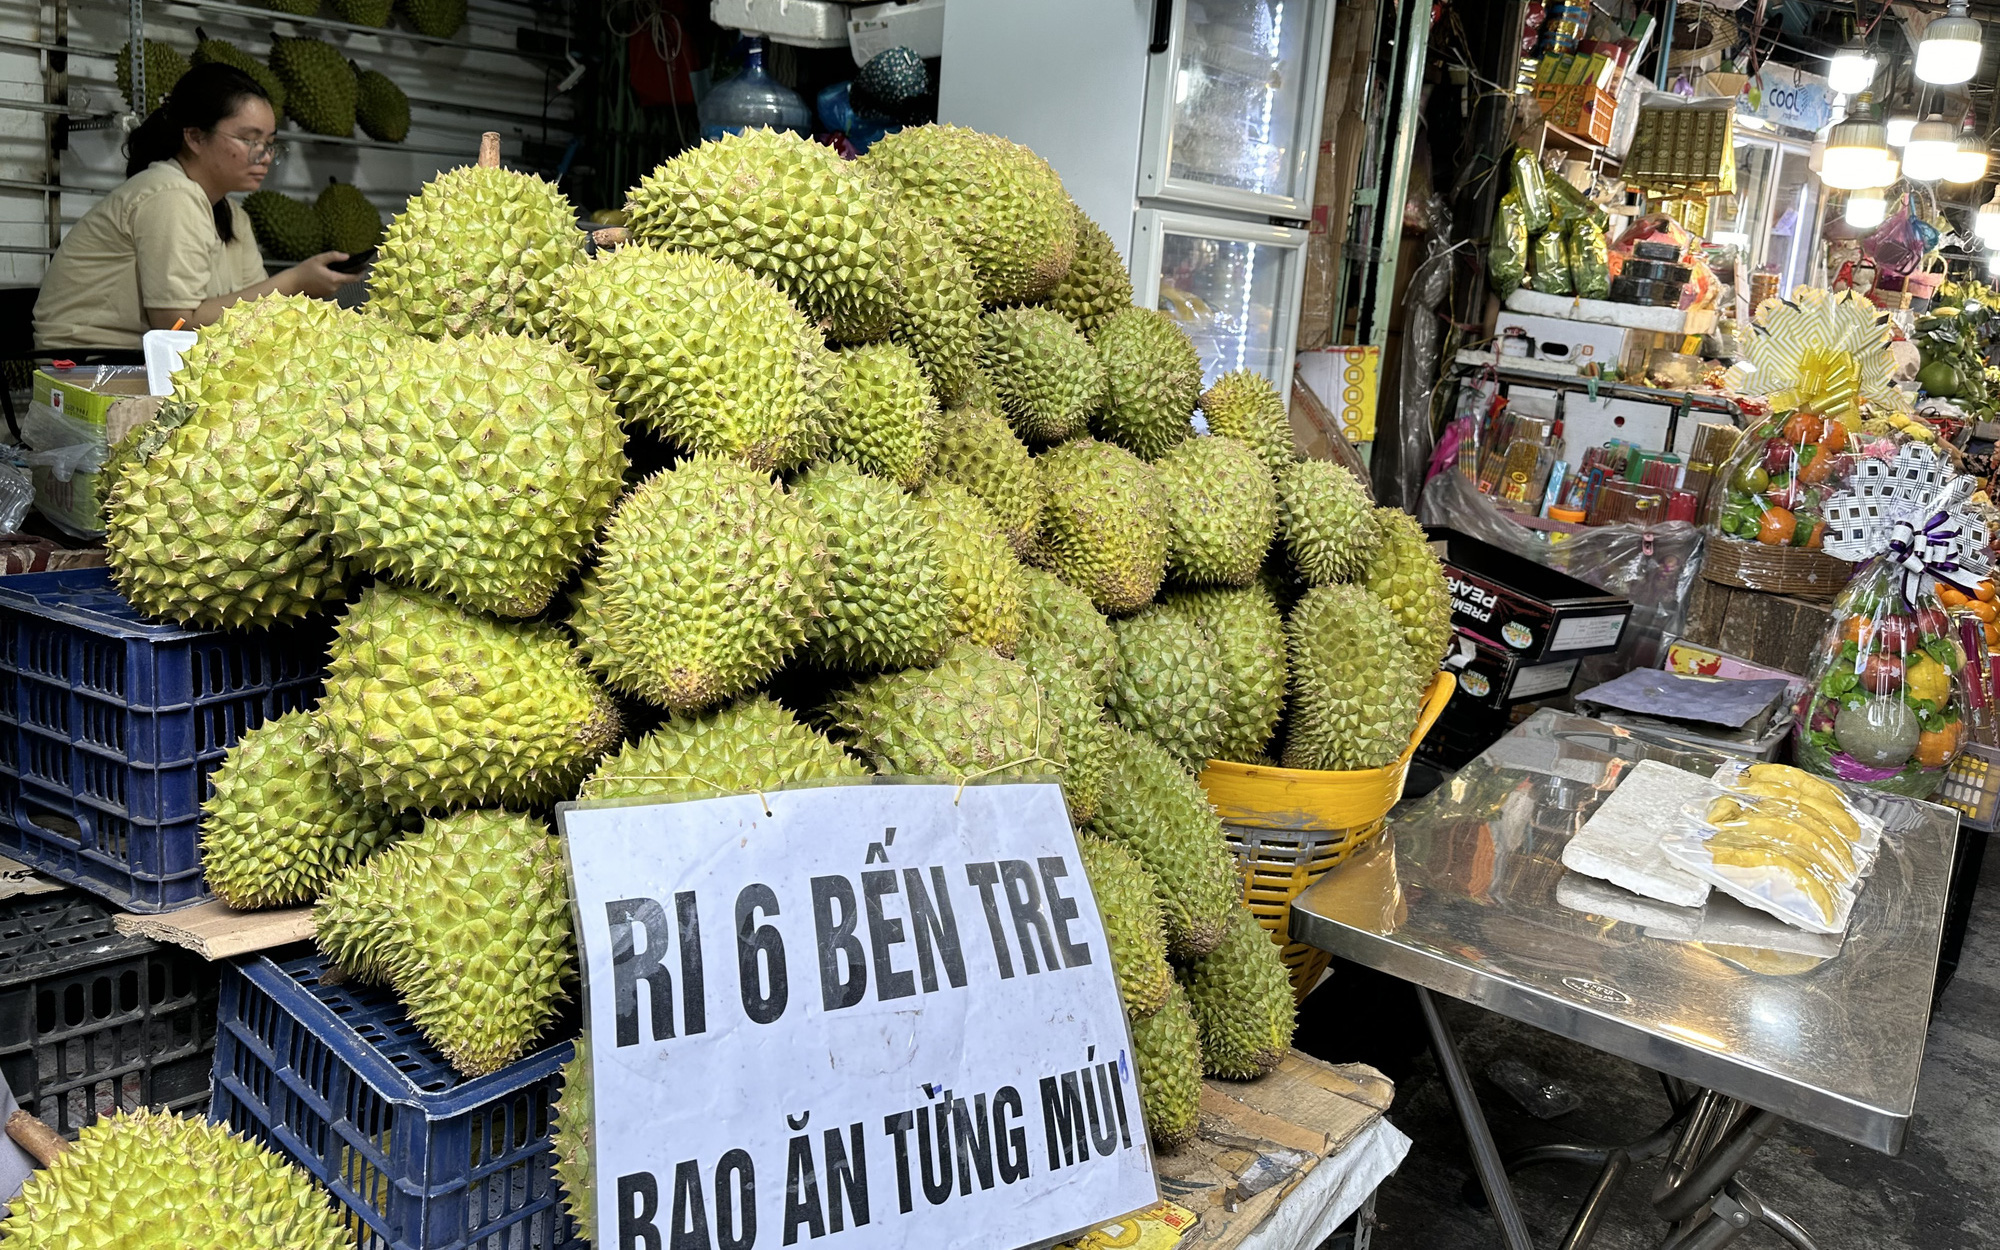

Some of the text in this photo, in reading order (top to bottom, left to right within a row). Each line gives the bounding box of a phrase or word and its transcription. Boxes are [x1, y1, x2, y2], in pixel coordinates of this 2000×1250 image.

[1446, 576, 1498, 609] PEAR
[605, 827, 1092, 1048] RI 6 BẾN TRE
[617, 1045, 1132, 1250] BAO ĂN TỪNG MÚI
